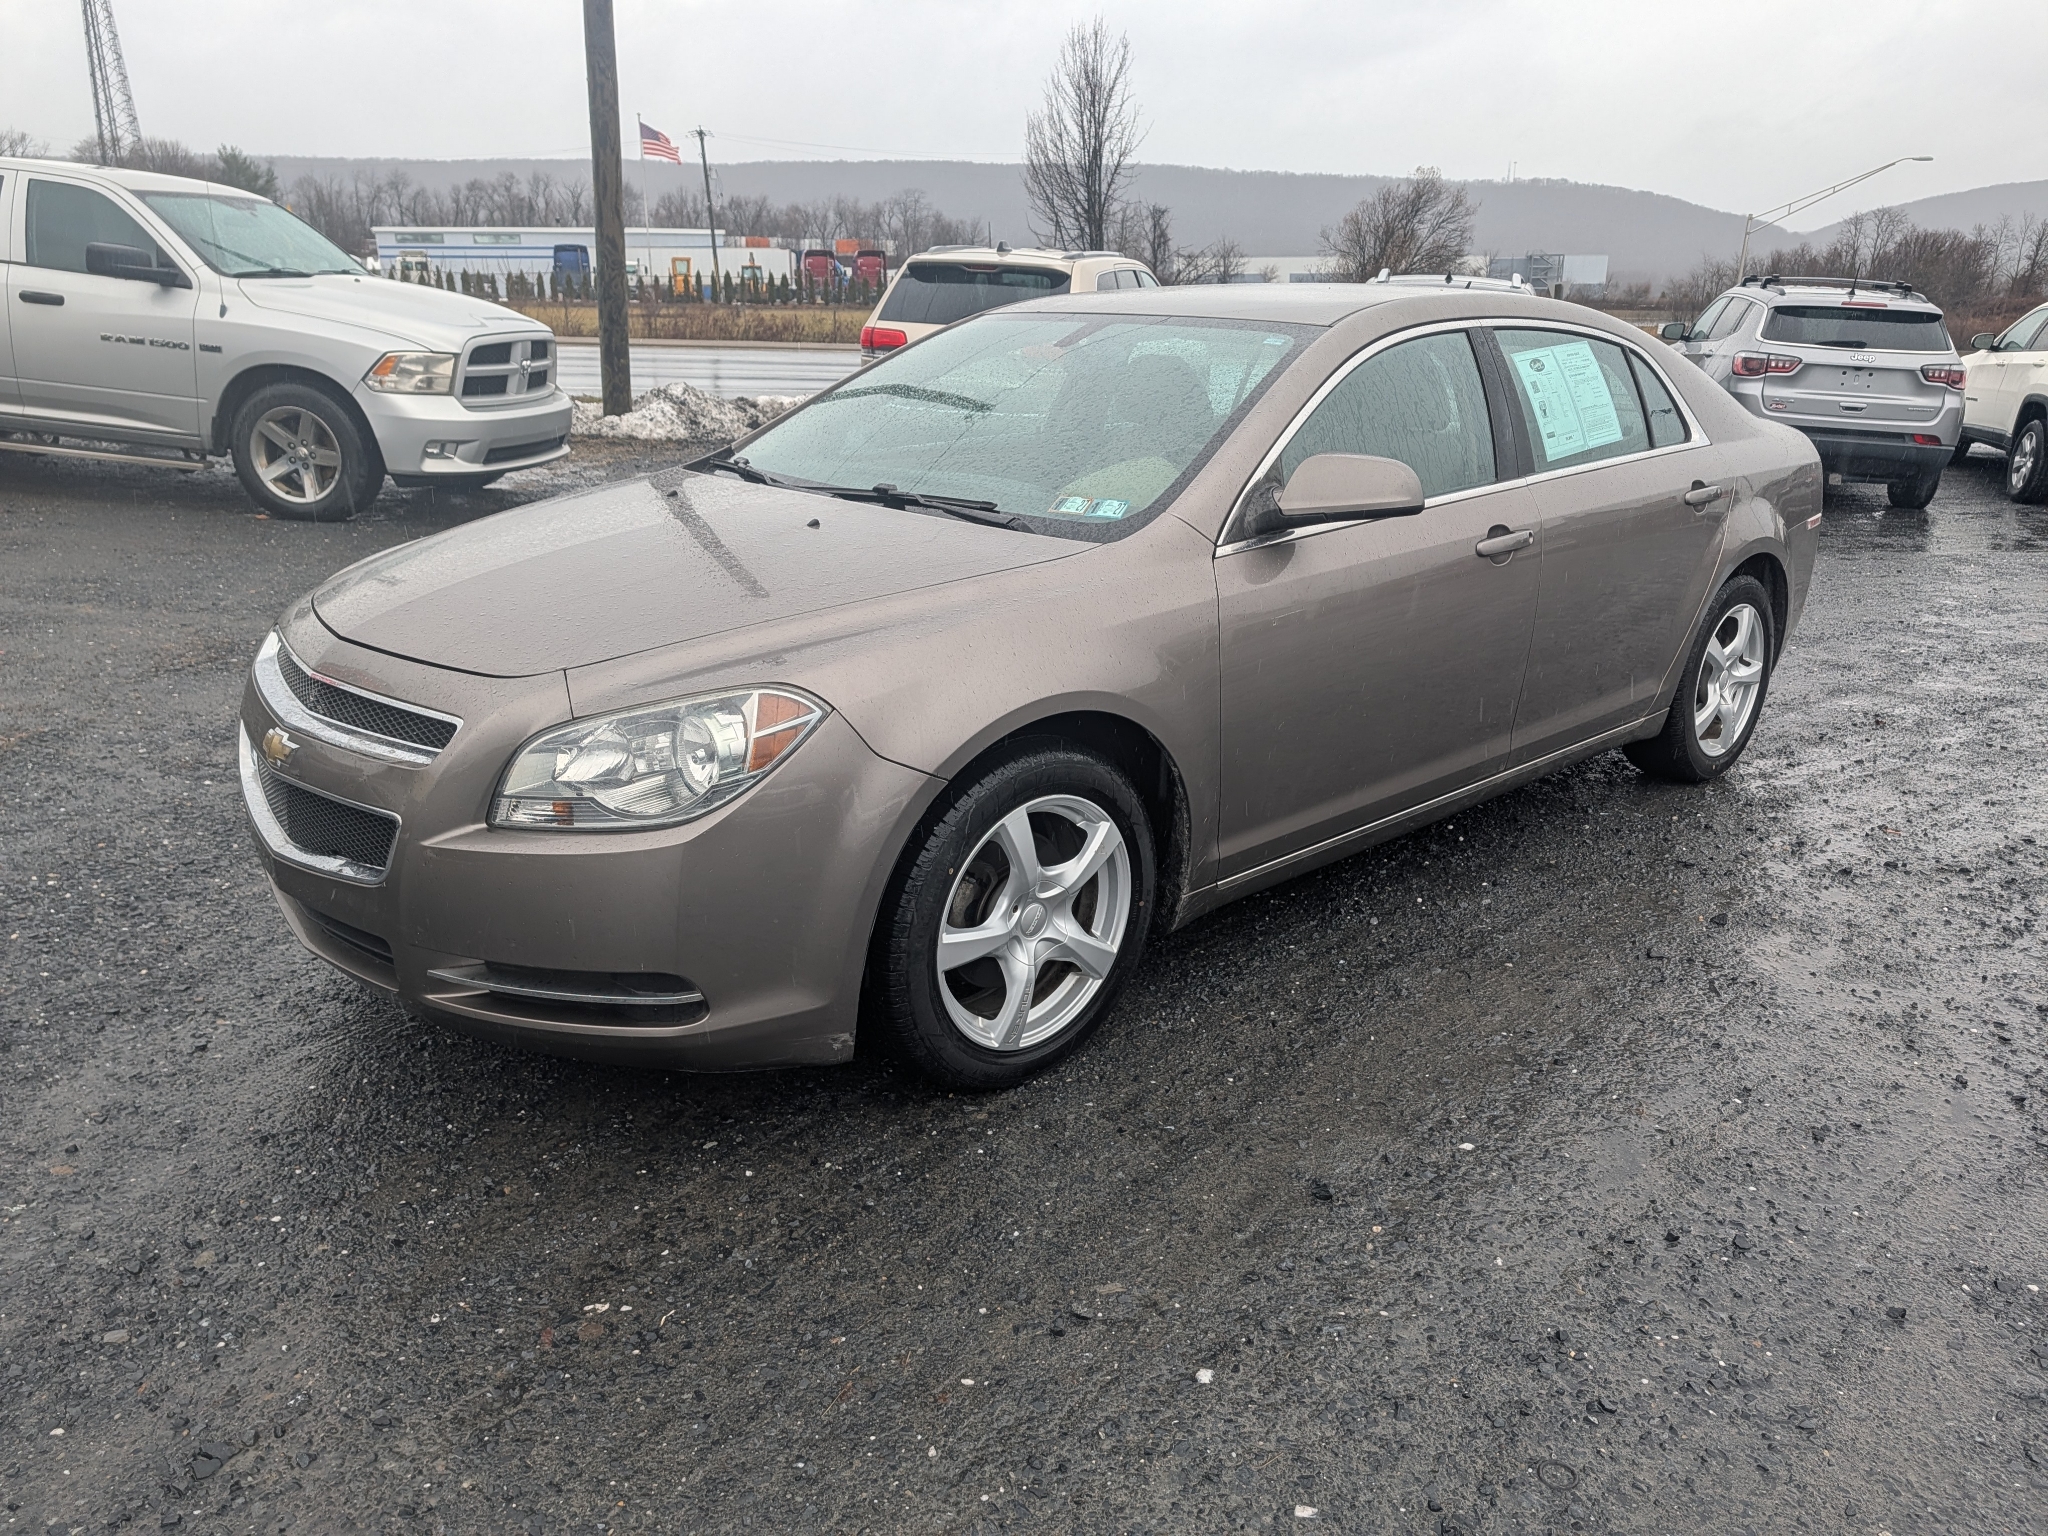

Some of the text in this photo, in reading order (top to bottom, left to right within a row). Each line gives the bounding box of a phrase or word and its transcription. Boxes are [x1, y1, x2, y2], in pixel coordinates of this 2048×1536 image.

[100, 333, 145, 345] RAM
[148, 338, 190, 350] 1500
[1850, 353, 1876, 363] Jeep
[1005, 983, 1033, 1046] TOUREN
